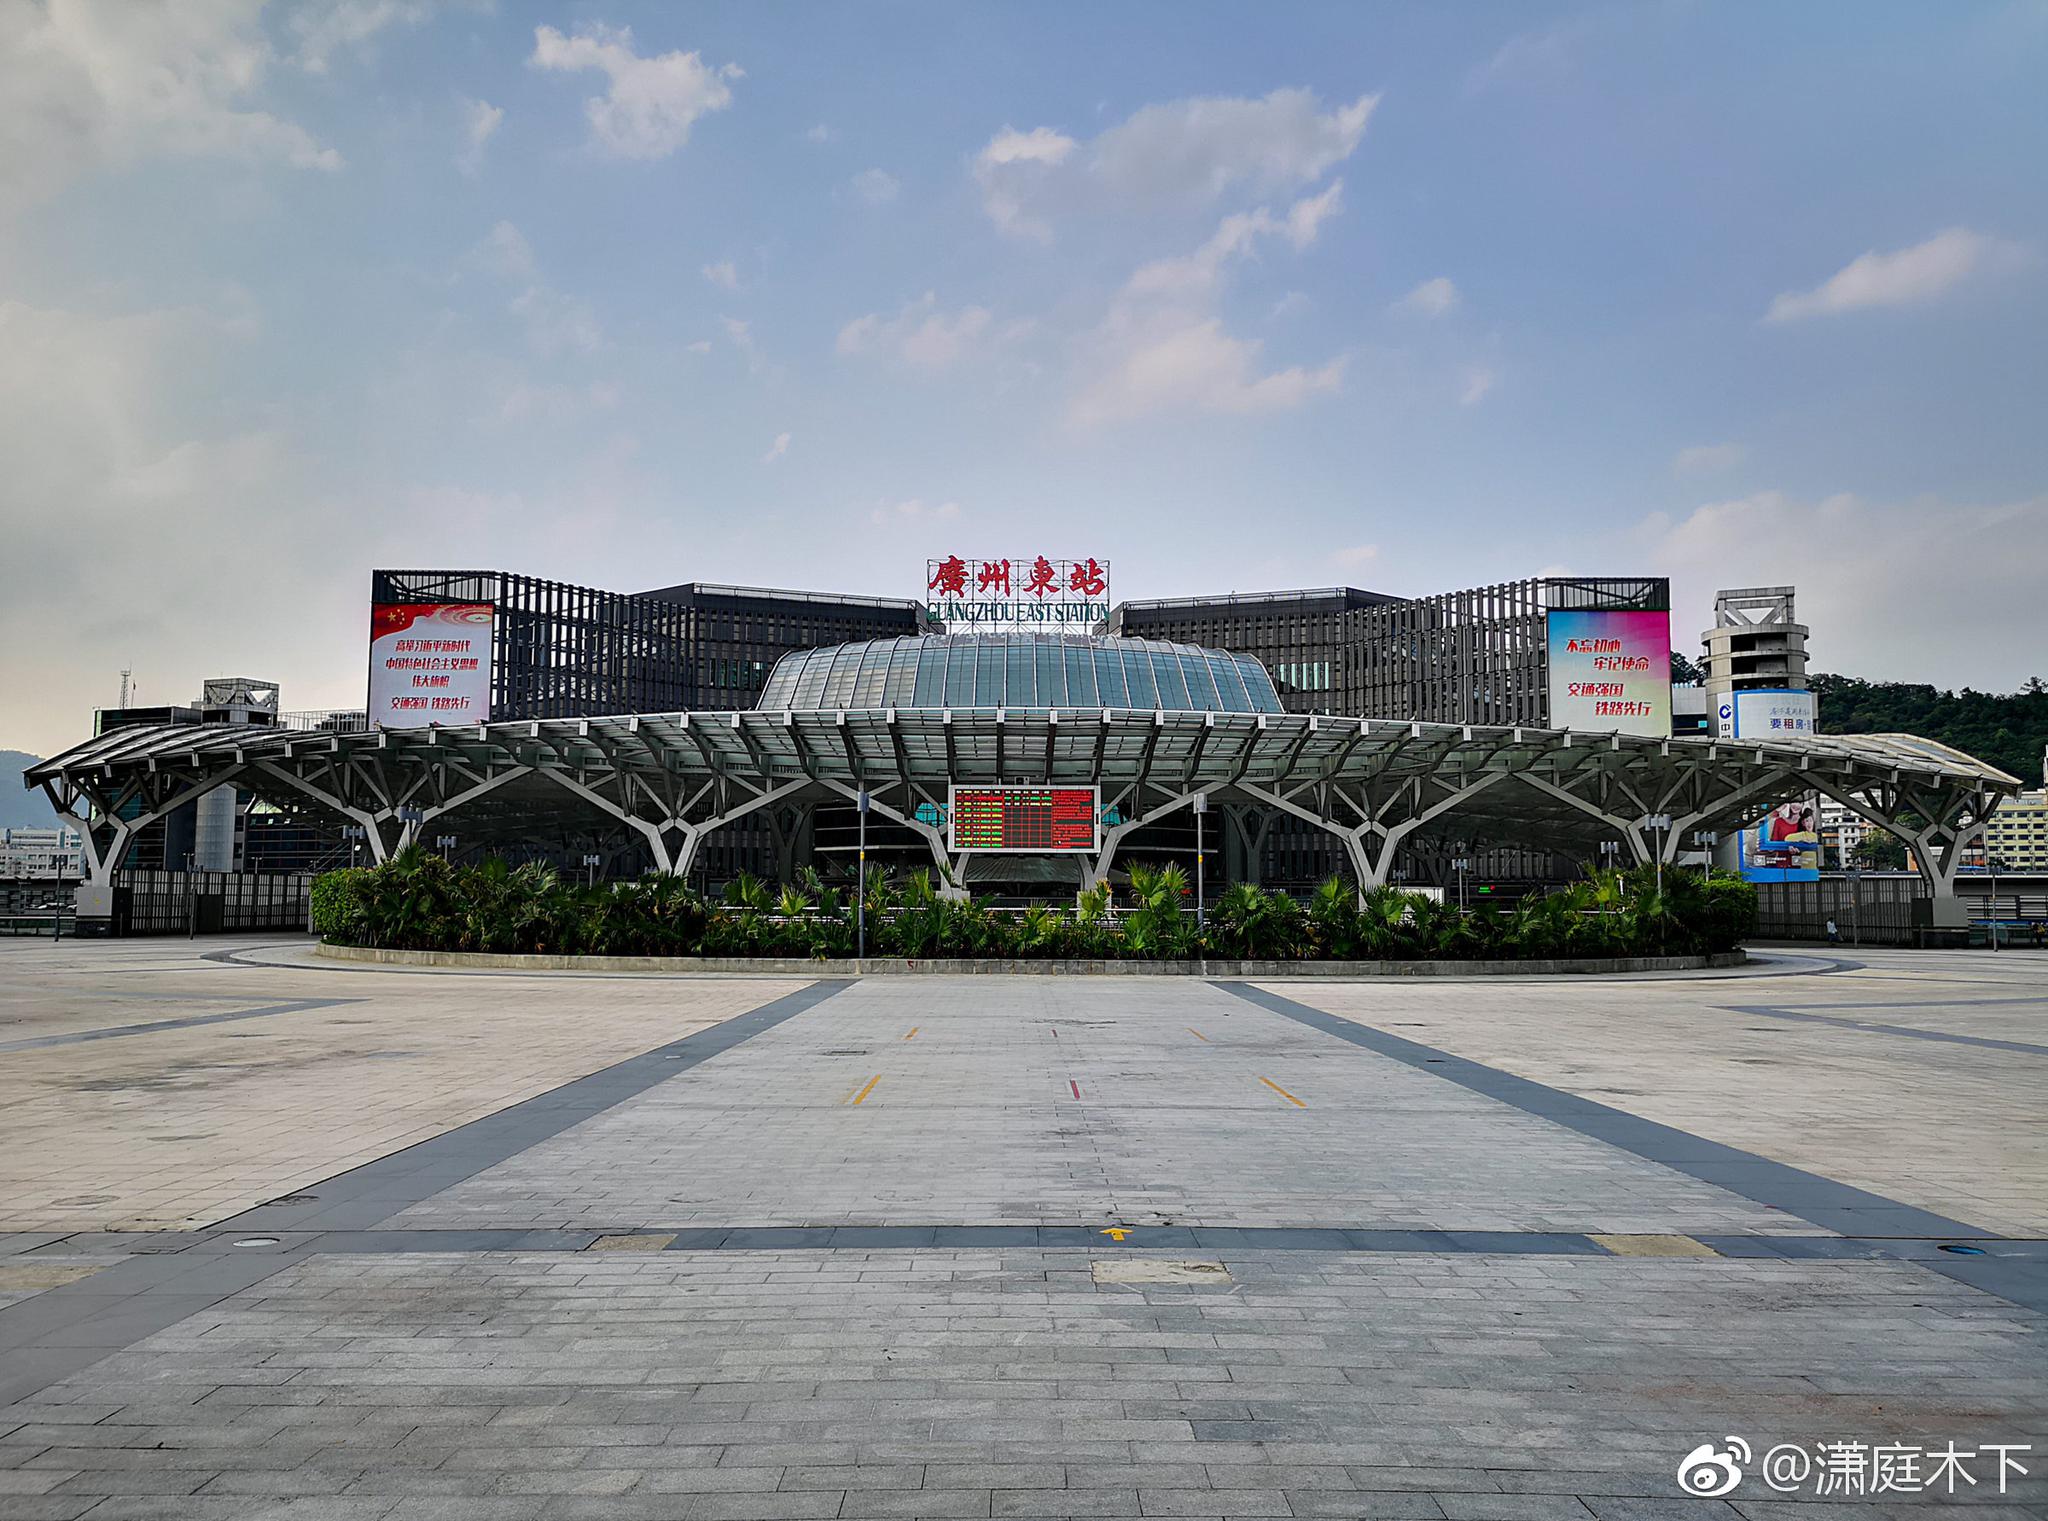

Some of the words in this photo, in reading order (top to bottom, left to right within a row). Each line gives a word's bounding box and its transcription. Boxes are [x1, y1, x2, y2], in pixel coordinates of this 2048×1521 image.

[929, 555, 1106, 598] 廣州東站
[927, 602, 1014, 622] GUANGZHOU
[1017, 603, 1051, 622] EAST
[1055, 602, 1110, 622] STATION
[395, 640, 471, 652] 高举习近平新时代
[1567, 639, 1621, 653] 不忘初心
[386, 657, 478, 671] 中国特色社会主义思想
[1593, 656, 1649, 671] 牢记使命
[1568, 682, 1624, 698] 交通强国
[1595, 701, 1652, 717] 铁路先行
